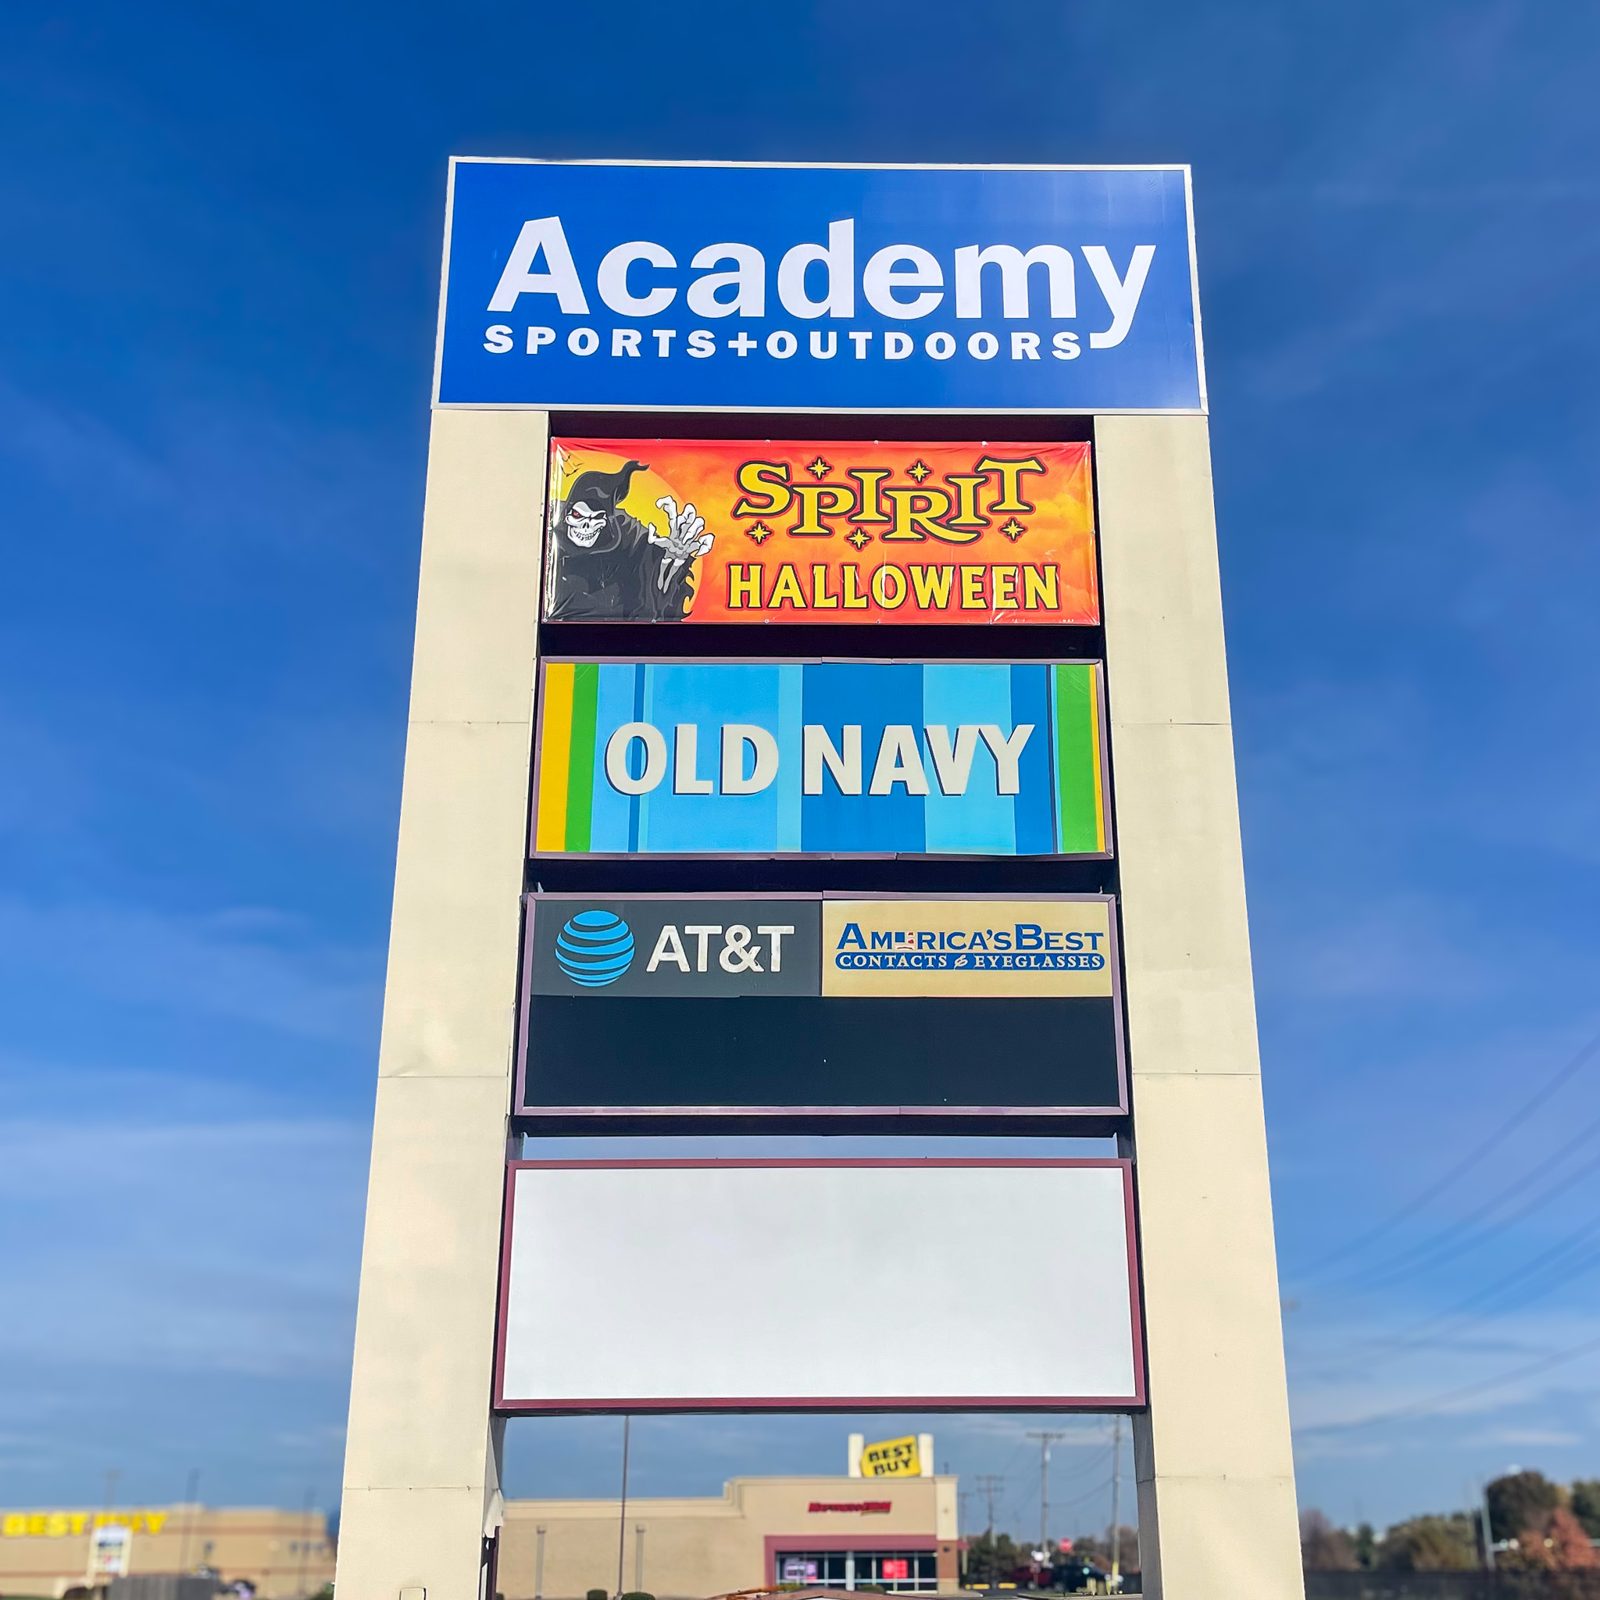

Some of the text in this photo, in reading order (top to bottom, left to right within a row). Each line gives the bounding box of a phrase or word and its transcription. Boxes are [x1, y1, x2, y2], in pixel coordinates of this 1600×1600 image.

[487, 216, 1156, 349] Academy
[733, 456, 1046, 544] SPIRIT
[726, 564, 1060, 611] HALLOWEEN
[605, 722, 1035, 796] OLD NAVY
[646, 924, 795, 973] AT&T
[838, 955, 948, 969] CONTACTS
[973, 955, 1102, 969] EYEGLASSES
[868, 1443, 913, 1462] BEST
[874, 1458, 911, 1475] BUY
